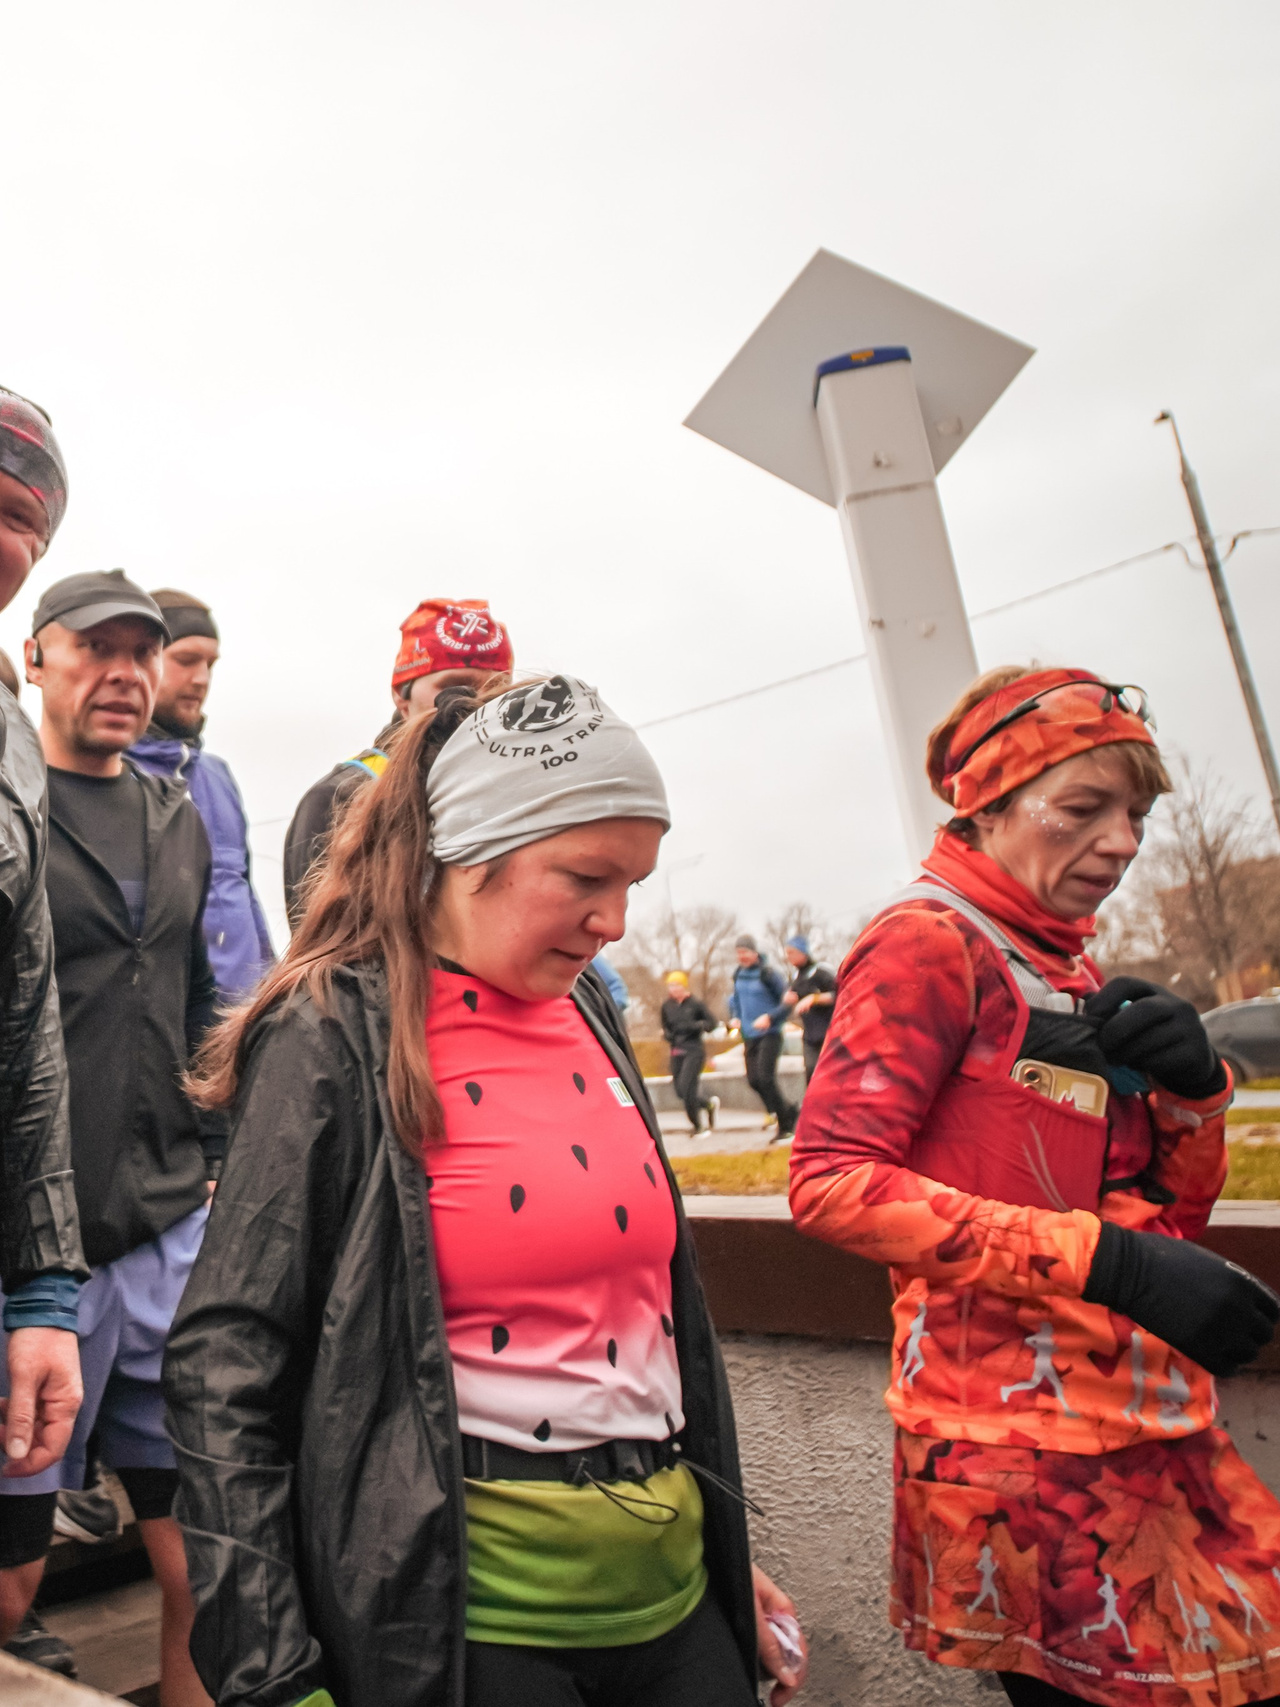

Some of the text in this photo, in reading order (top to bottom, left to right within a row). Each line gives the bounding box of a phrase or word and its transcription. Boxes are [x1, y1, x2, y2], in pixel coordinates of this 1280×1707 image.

[489, 713, 604, 758] ULTRA TRAIL
[540, 751, 579, 770] 100
